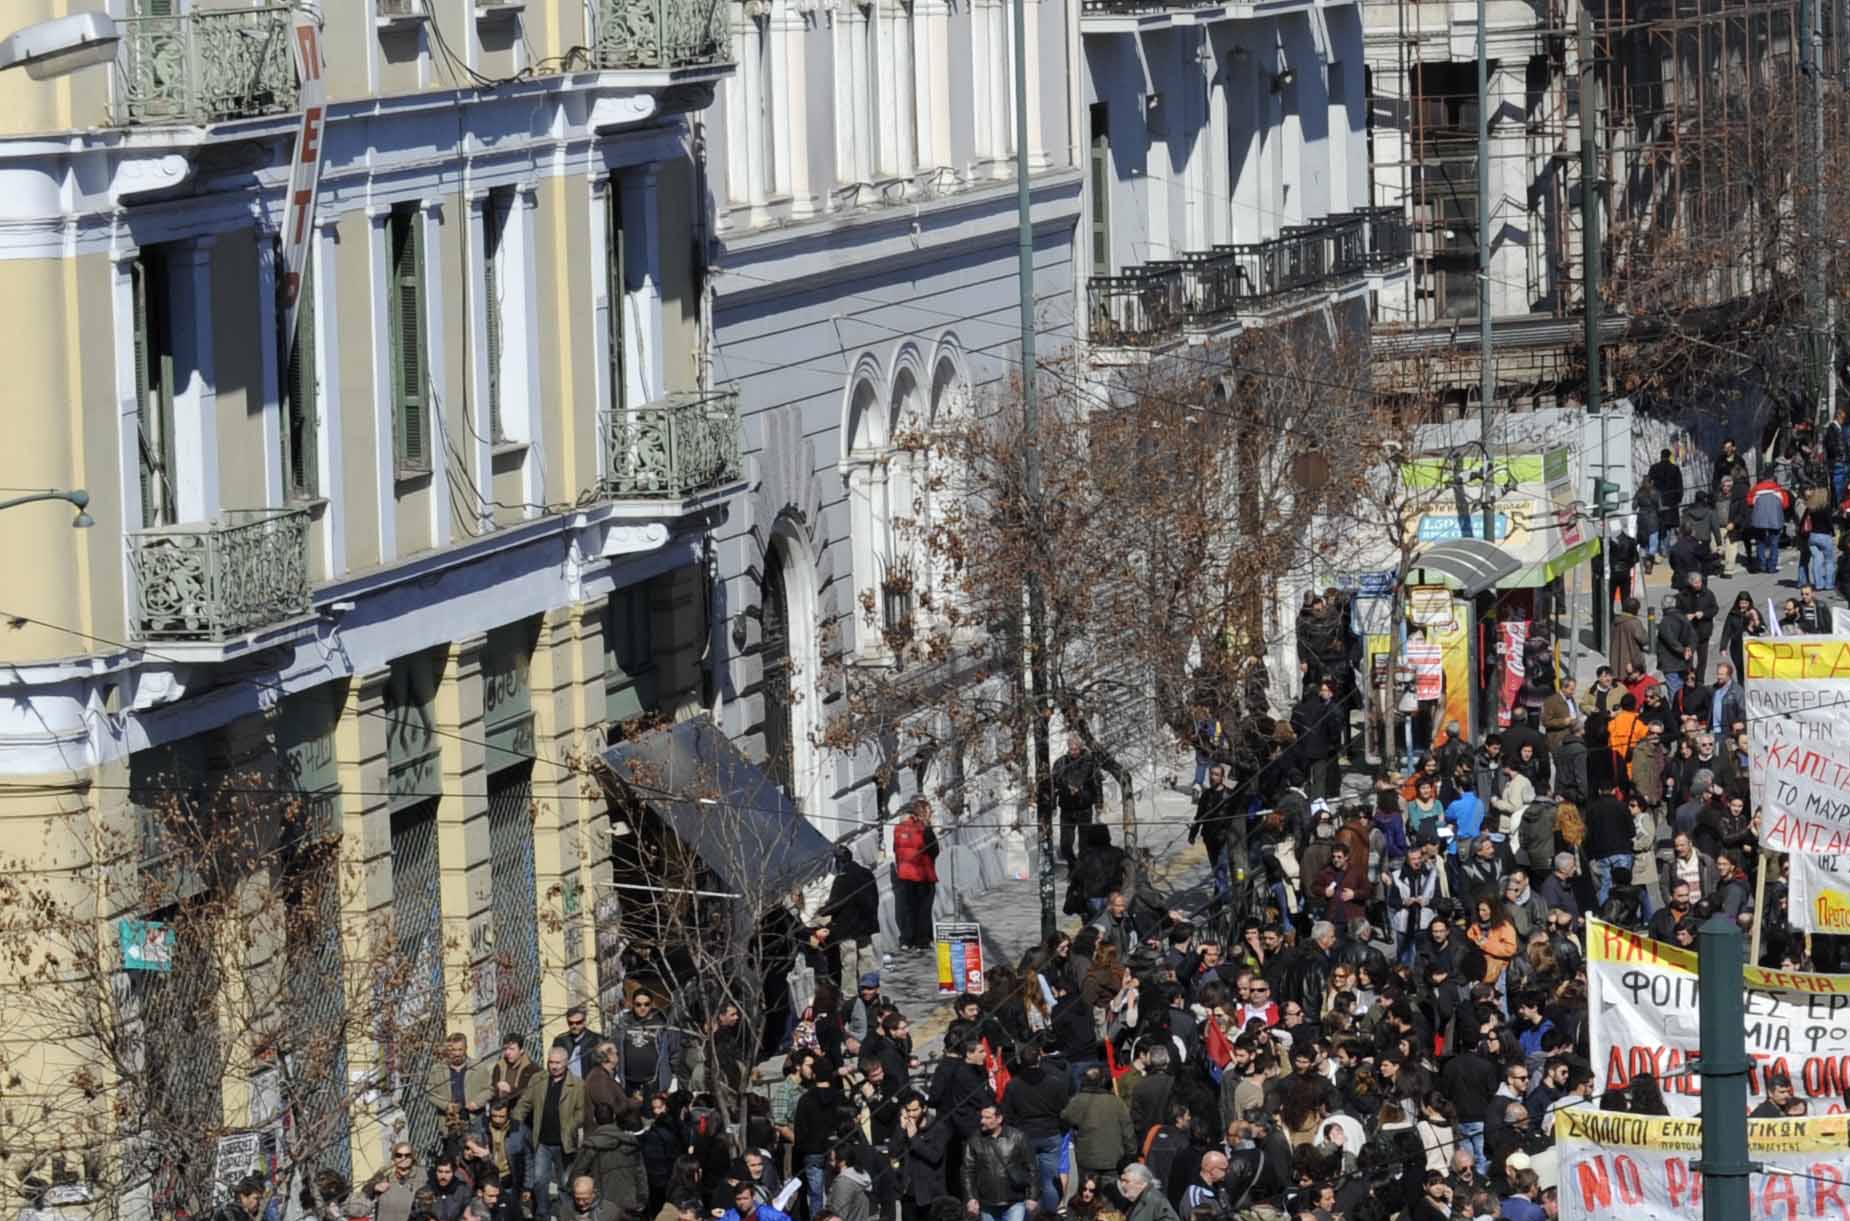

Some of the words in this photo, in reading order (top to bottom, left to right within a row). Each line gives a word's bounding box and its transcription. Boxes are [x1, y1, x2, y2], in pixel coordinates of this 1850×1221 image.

[1796, 719, 1833, 739] ΤΗΝ
[1777, 779, 1799, 806] ΤΟ
[1575, 1153, 1644, 1213] NO
